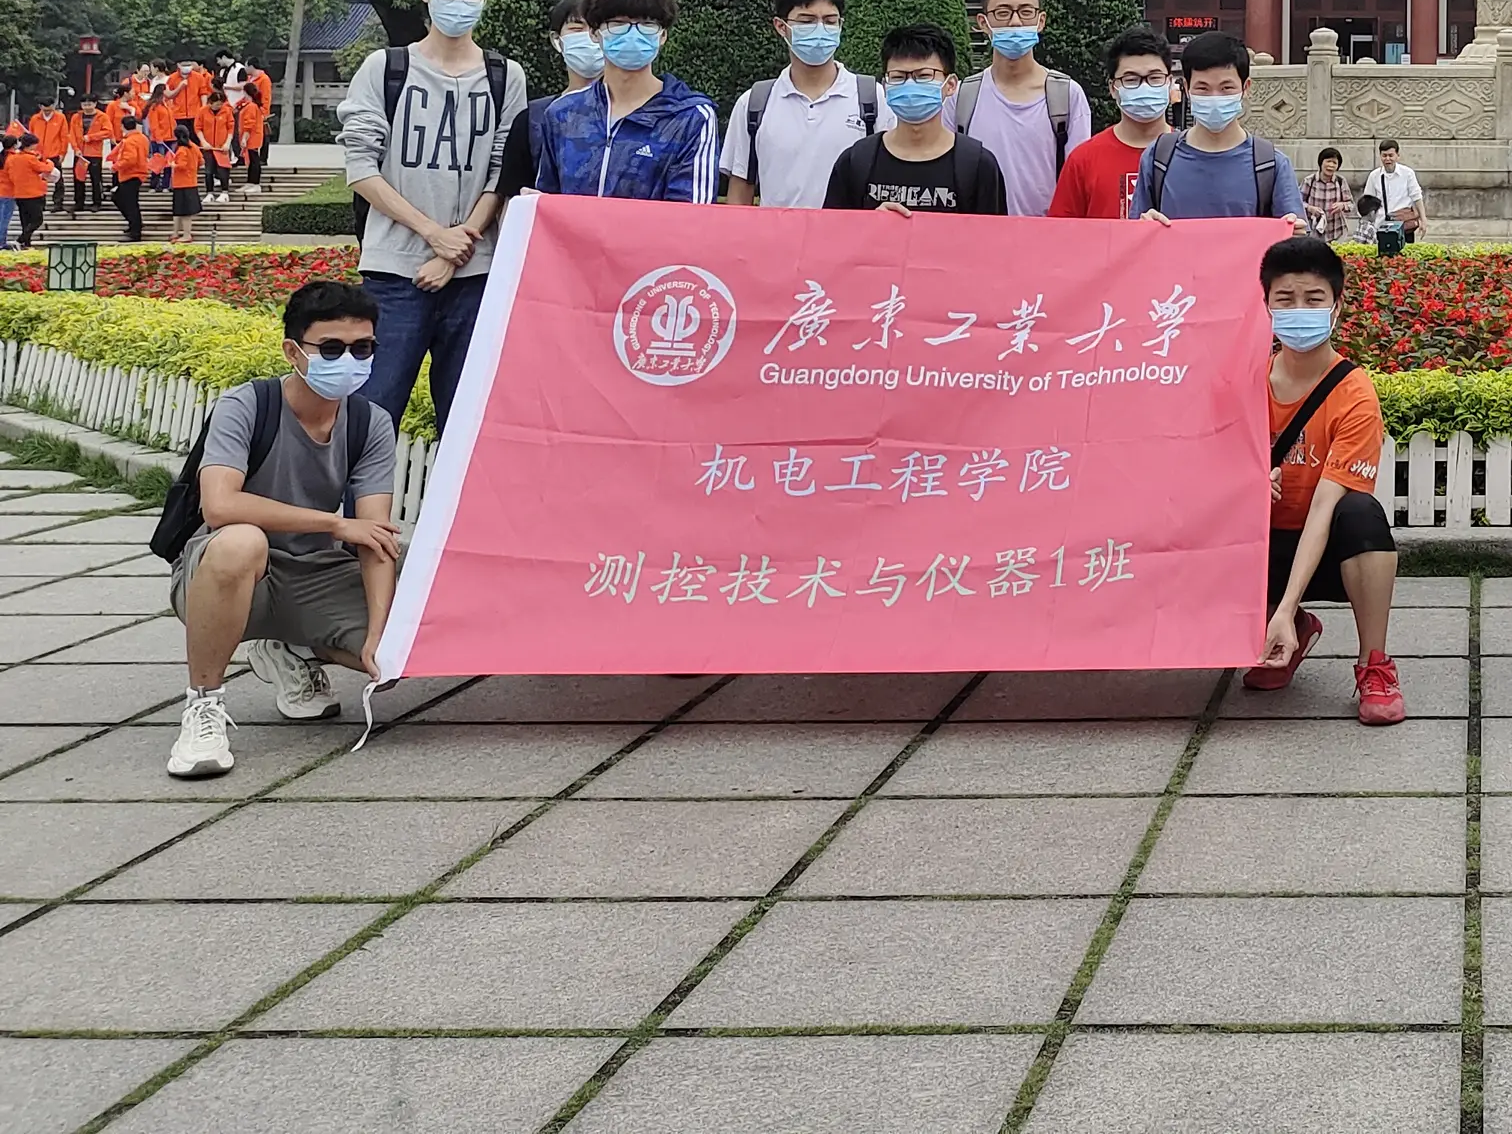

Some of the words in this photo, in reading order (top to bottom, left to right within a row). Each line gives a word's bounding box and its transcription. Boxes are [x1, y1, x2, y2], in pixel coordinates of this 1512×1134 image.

[401, 85, 490, 172] GAP
[647, 281, 698, 298] UNIVERSITY
[699, 289, 712, 300] OF
[629, 298, 647, 351] GUANGDONG
[702, 301, 720, 355] TECHNOLOGY
[759, 362, 900, 388] Guangdong
[905, 365, 1024, 396] University
[1029, 369, 1052, 391] of
[1056, 361, 1189, 389] Technology
[695, 443, 1072, 502] 机电工程学院
[584, 538, 1136, 609] 测控技术与仪器1班
